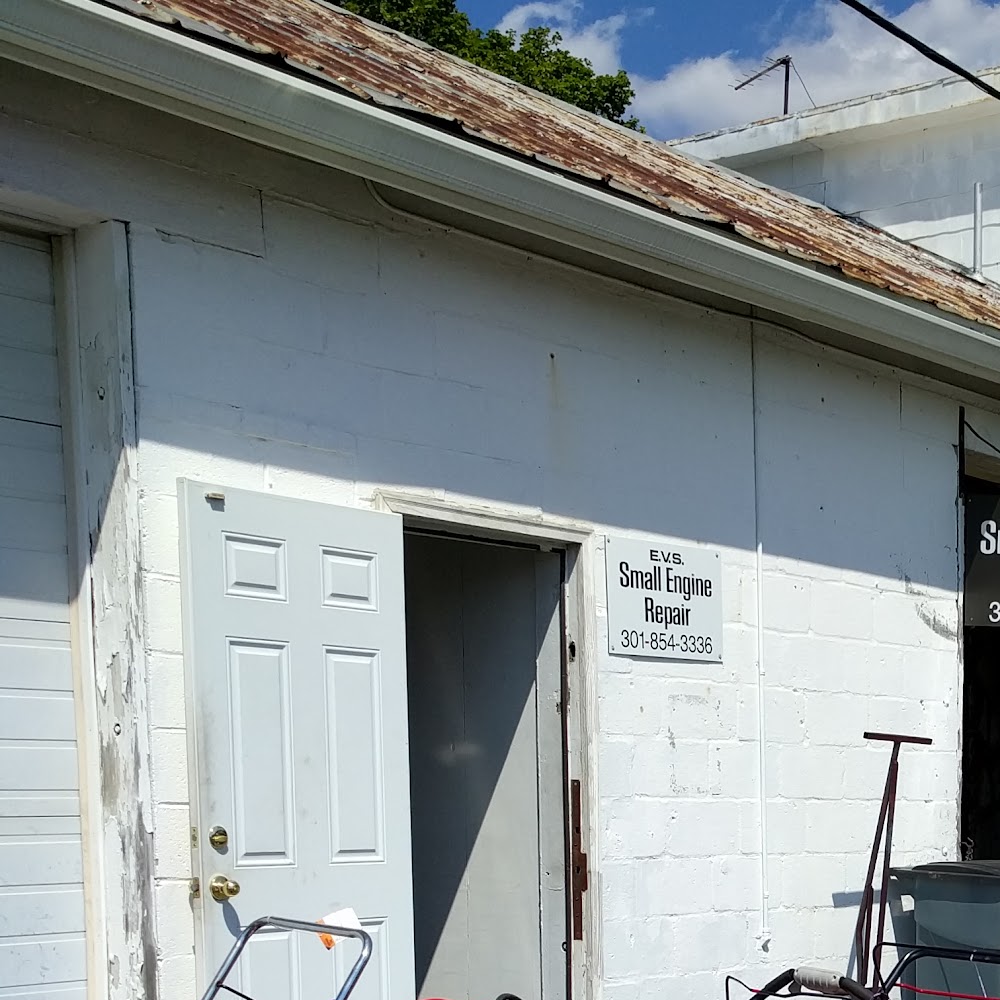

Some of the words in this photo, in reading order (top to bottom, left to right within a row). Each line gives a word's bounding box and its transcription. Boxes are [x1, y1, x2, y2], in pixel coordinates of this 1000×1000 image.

[649, 549, 685, 565] E.V.S.
[619, 561, 661, 591] Small
[666, 567, 712, 601] Engine
[644, 596, 691, 630] Repair
[621, 629, 713, 654] 301-854-3336
